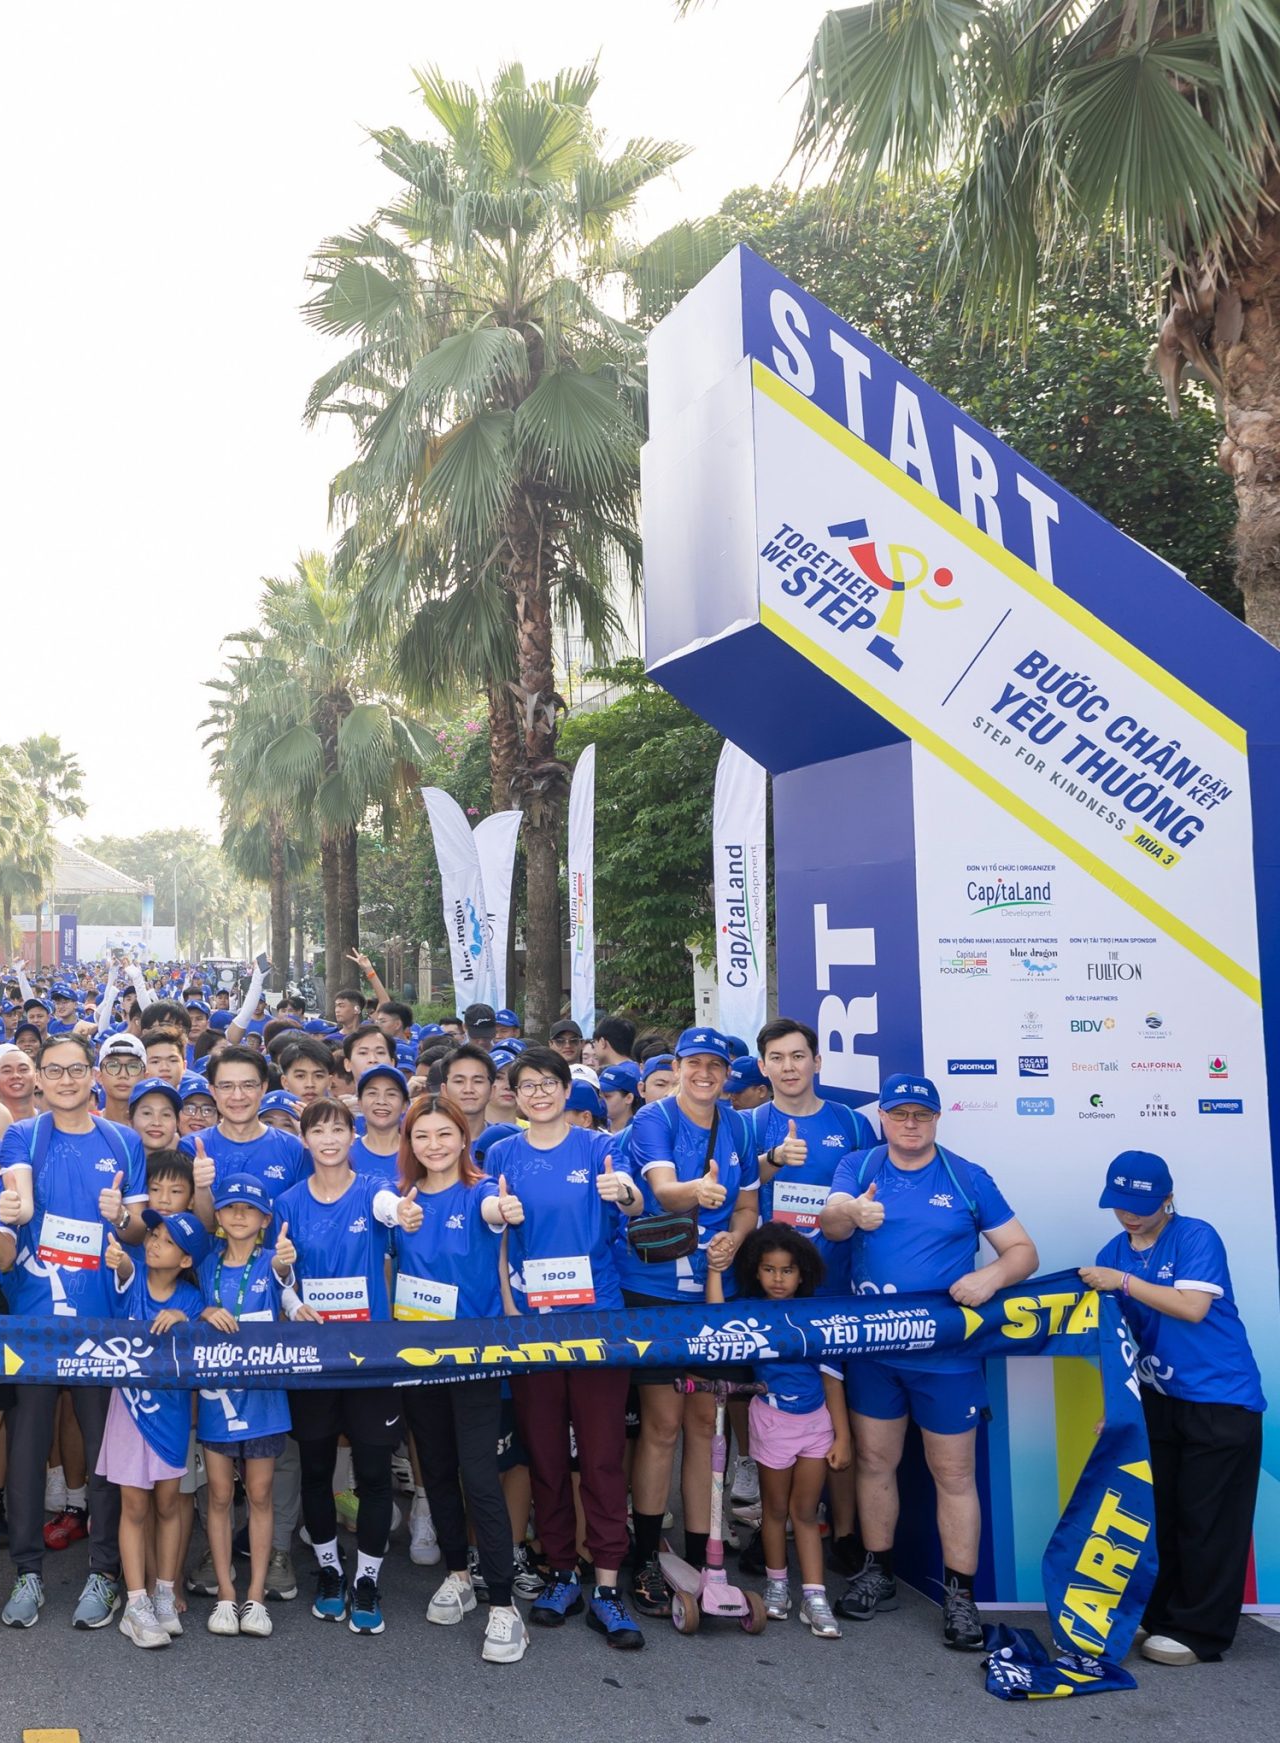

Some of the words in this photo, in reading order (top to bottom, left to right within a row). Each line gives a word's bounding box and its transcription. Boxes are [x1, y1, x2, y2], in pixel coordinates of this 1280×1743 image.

[769, 288, 1060, 586] START
[774, 523, 879, 605] TOGETHER
[760, 541, 798, 573] WE
[781, 566, 877, 633] STEP
[1013, 649, 1110, 723] BƯỚC
[1104, 715, 1201, 790] CHÂN
[972, 716, 1012, 745] STEP
[1015, 746, 1046, 774] FOR
[1049, 770, 1127, 831] KINDNESS
[990, 682, 1067, 745] YÊU
[1061, 733, 1205, 848] THƯƠNG
[1198, 772, 1233, 801] GẮN
[1187, 785, 1220, 811] KẾT
[1134, 834, 1164, 858] MÙA
[1163, 854, 1174, 866] 3
[751, 846, 760, 932] Development
[967, 878, 1051, 906] CapitaLand
[722, 845, 752, 988] CapitaLand
[1001, 909, 1051, 918] Development
[956, 950, 987, 959] CapitaLand
[1010, 948, 1027, 957] blue
[1030, 948, 1058, 958] dragon
[1108, 951, 1119, 961] THE
[940, 967, 988, 976] FOUNDATION
[1088, 963, 1142, 981] FULLTON
[1071, 1020, 1103, 1033] BIDV
[1072, 1062, 1119, 1072] BreadTalk
[781, 1194, 825, 1206] 5H014
[796, 1216, 816, 1224] 5KM
[56, 1231, 90, 1244] 2810
[541, 1270, 576, 1281] 1909
[308, 1290, 364, 1301] 000088
[412, 1291, 442, 1305] 1108
[1001, 1290, 1098, 1339] STA
[820, 1323, 858, 1345] YÊU
[863, 1319, 936, 1343] THƯƠNG
[688, 1343, 706, 1355] WE
[707, 1341, 756, 1361] STEP
[821, 1348, 846, 1356] STEP
[847, 1346, 862, 1354] FOR
[866, 1343, 905, 1353] KINDNESS
